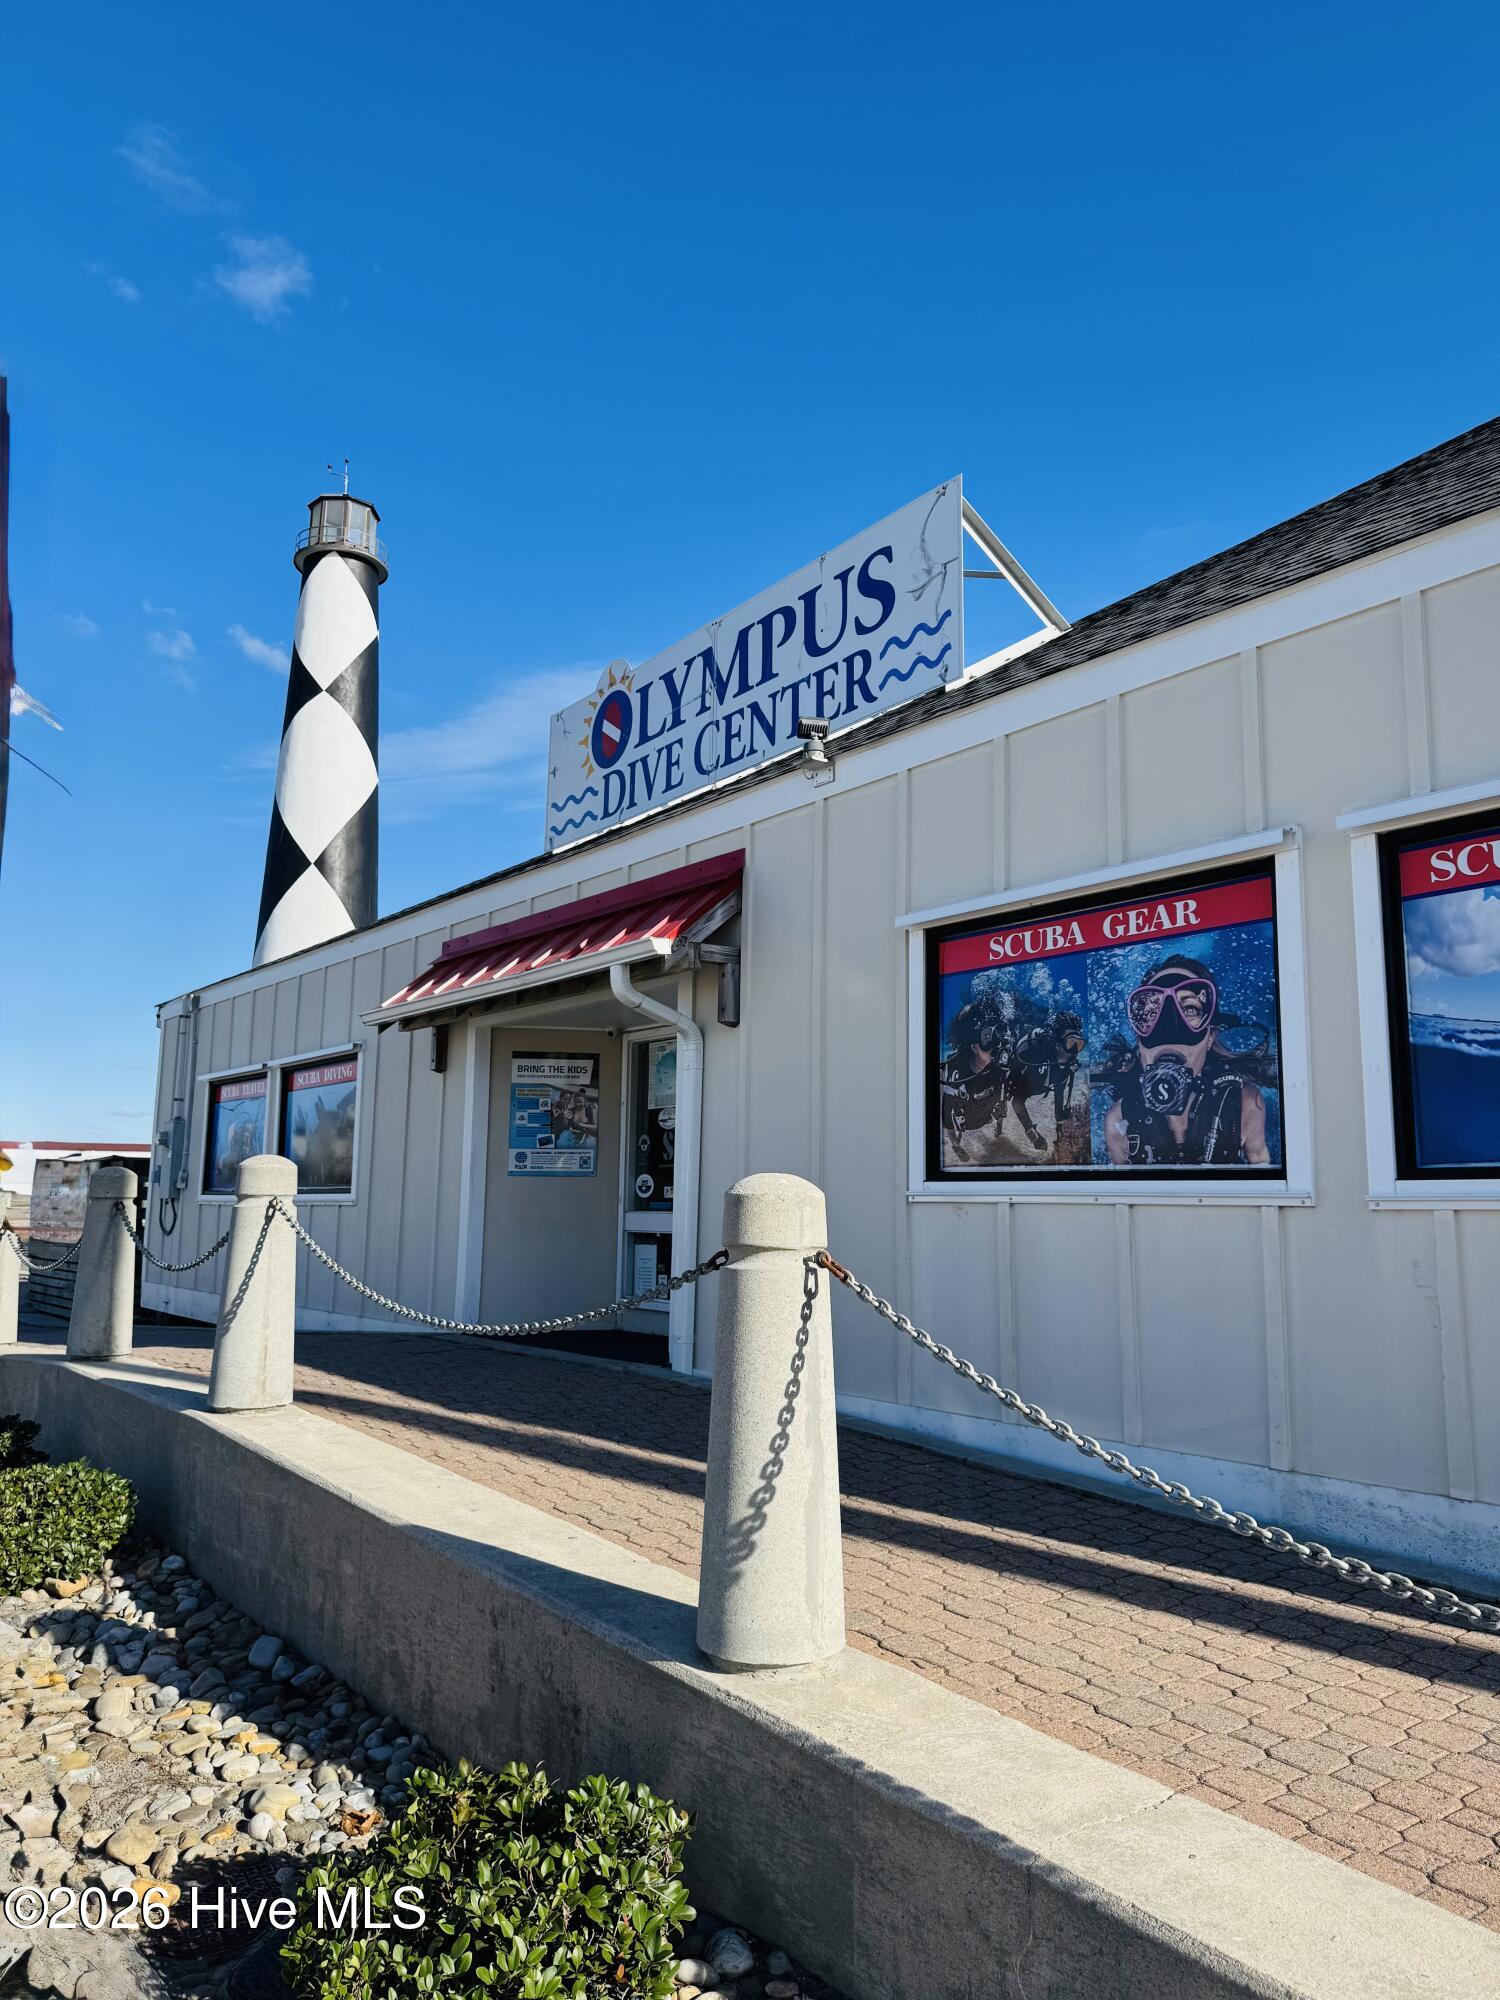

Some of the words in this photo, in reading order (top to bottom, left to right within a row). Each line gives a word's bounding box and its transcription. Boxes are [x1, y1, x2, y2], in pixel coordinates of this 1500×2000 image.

[591, 545, 896, 769] OLYMPUS
[600, 738, 685, 820] DIVE
[693, 648, 878, 776] CENTER
[989, 920, 1085, 960] SCUBA
[1103, 899, 1200, 939] GEAR
[221, 1086, 239, 1099] SCUBA
[242, 1080, 266, 1096] TRAVEL
[296, 1070, 321, 1087] SCUBA
[323, 1064, 353, 1081] DIVING
[517, 1064, 546, 1073] BRING
[547, 1065, 566, 1074] THE
[567, 1065, 588, 1074] KIDS
